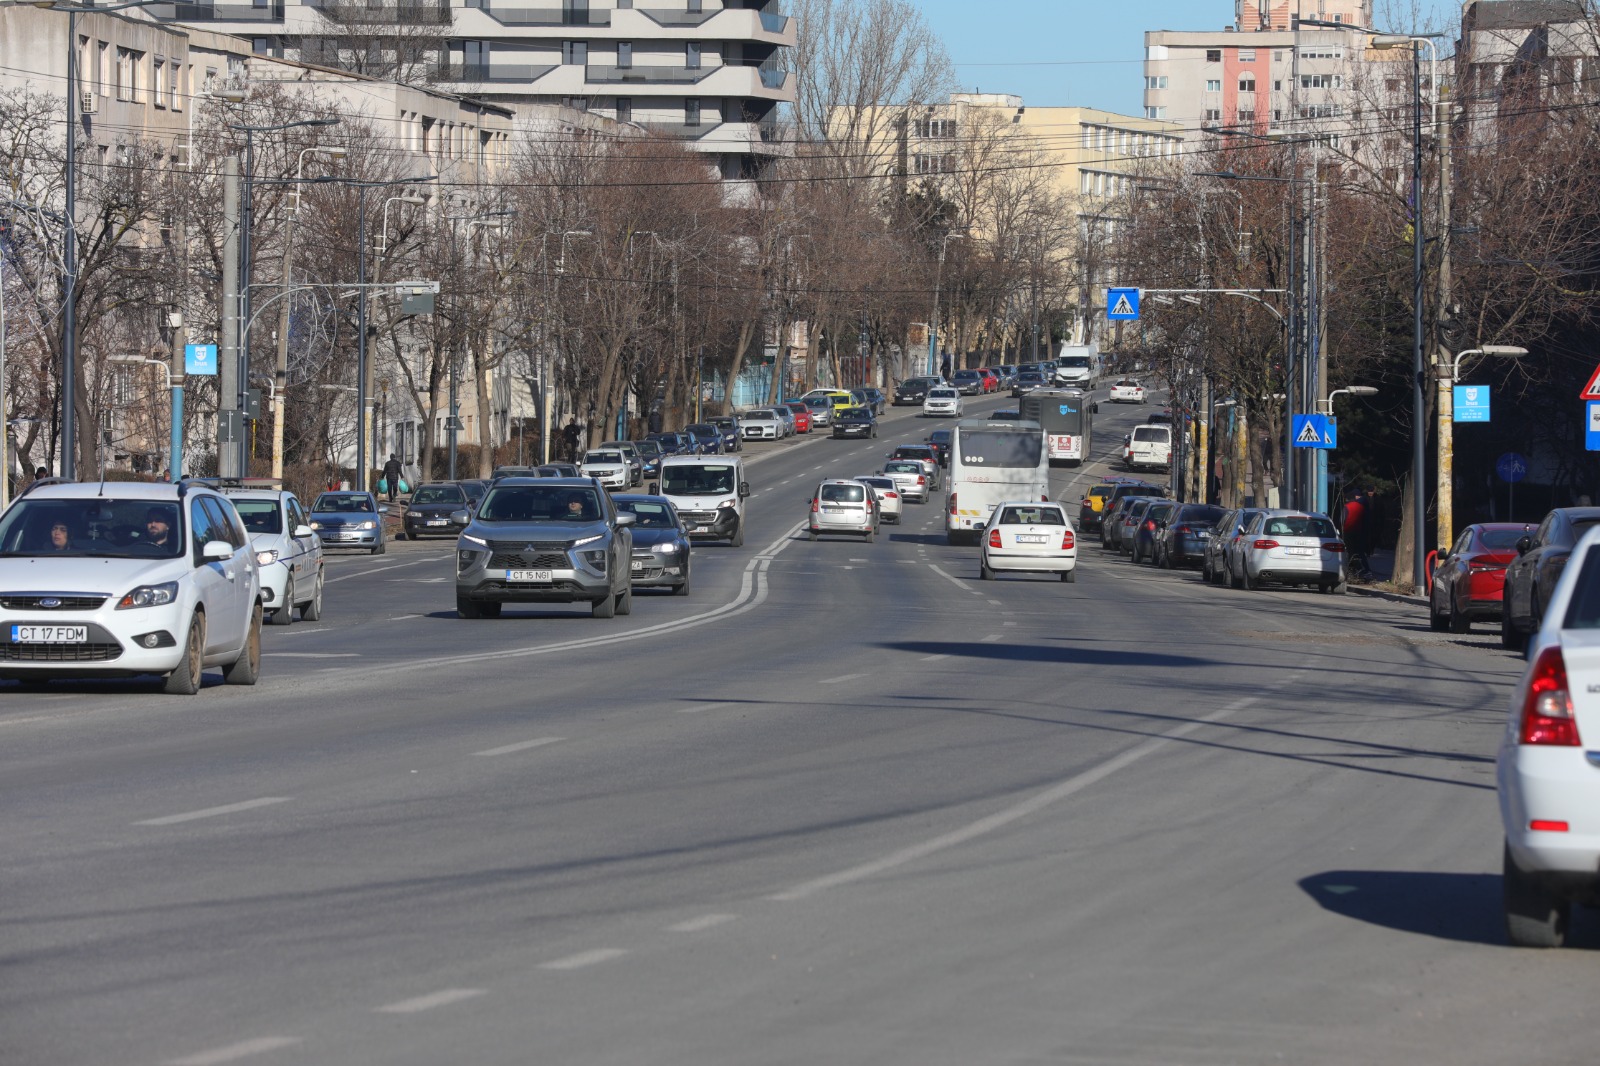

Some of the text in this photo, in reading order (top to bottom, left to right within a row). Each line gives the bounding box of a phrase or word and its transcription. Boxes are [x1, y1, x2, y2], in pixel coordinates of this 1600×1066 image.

[513, 571, 549, 579] CT 15 NGI
[20, 627, 84, 640] CT 17 FDM
